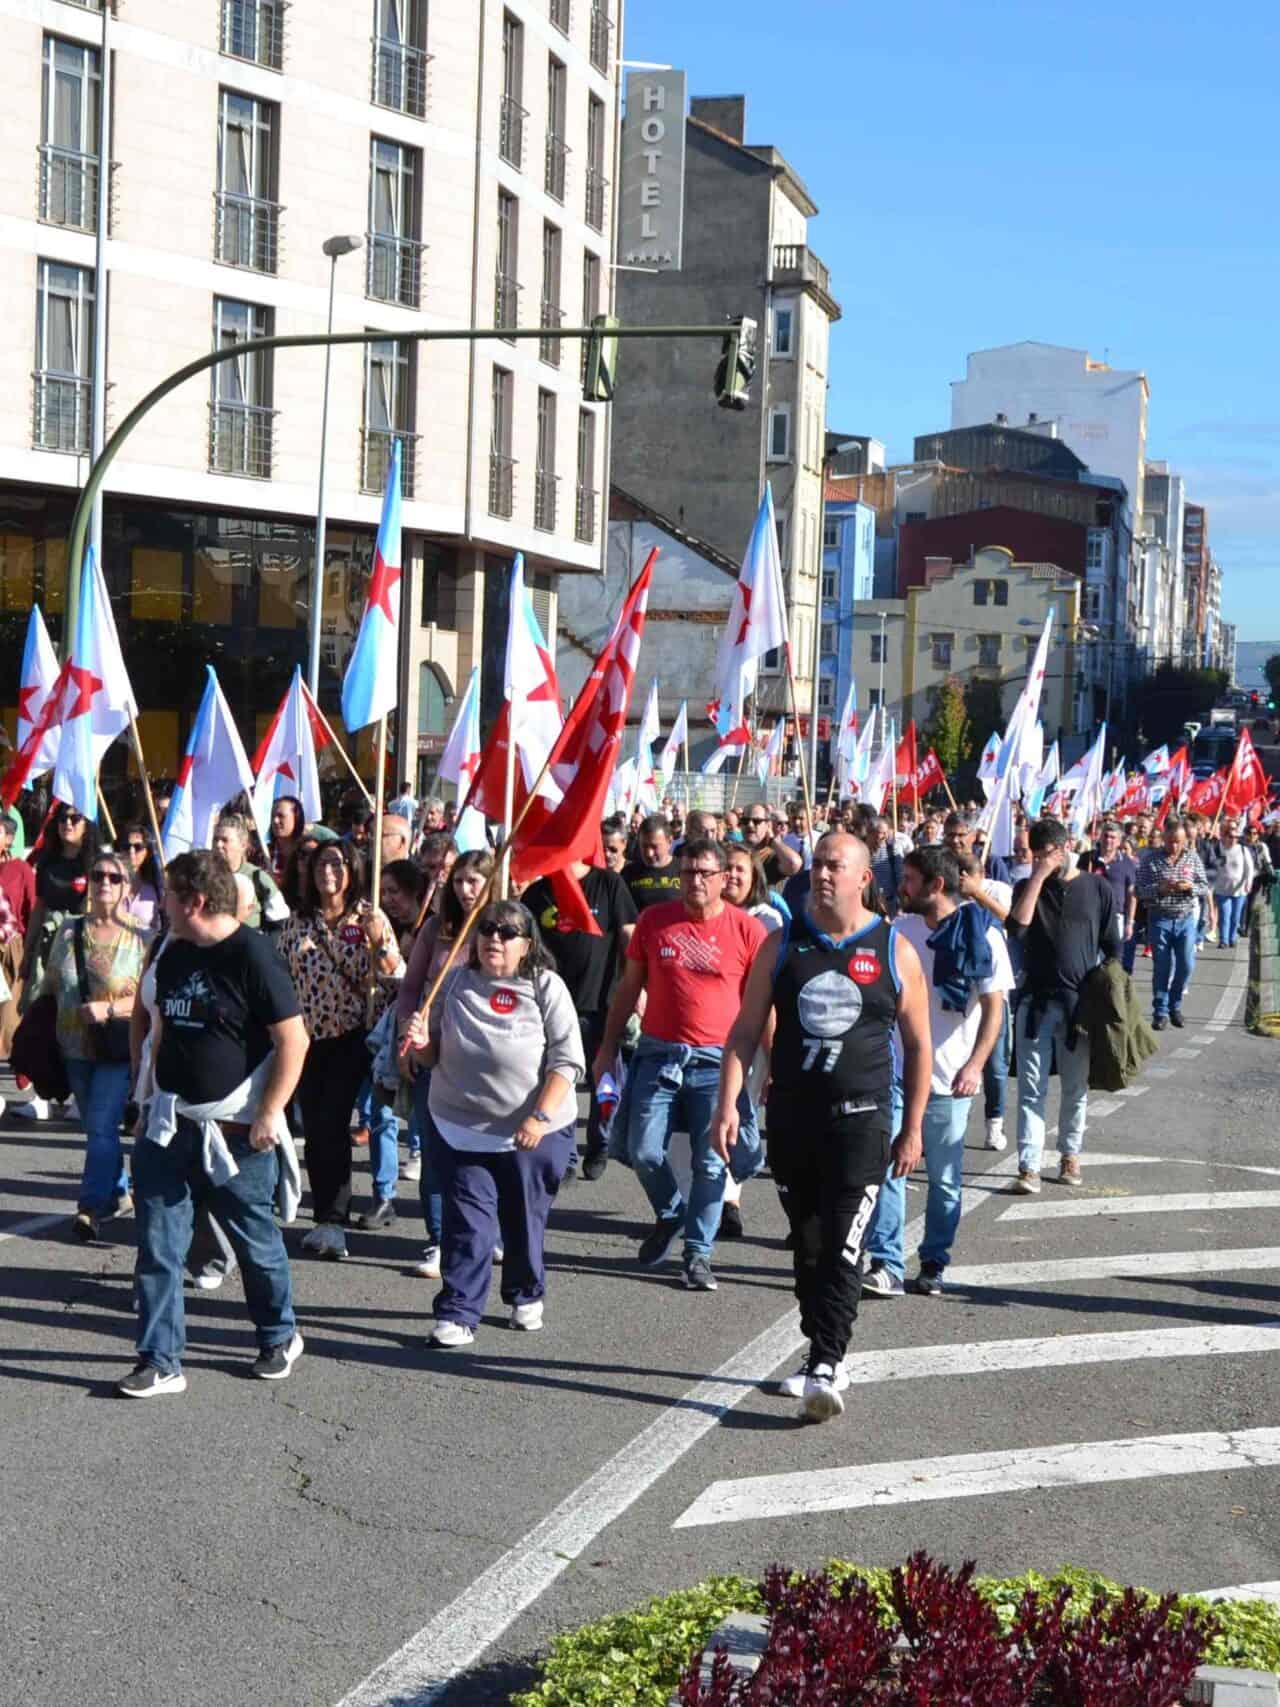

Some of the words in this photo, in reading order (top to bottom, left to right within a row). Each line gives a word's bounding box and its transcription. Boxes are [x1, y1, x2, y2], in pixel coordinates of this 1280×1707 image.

[641, 86, 665, 240] HOTEL
[802, 1039, 844, 1072] 77
[842, 1184, 880, 1266] LEGEA
